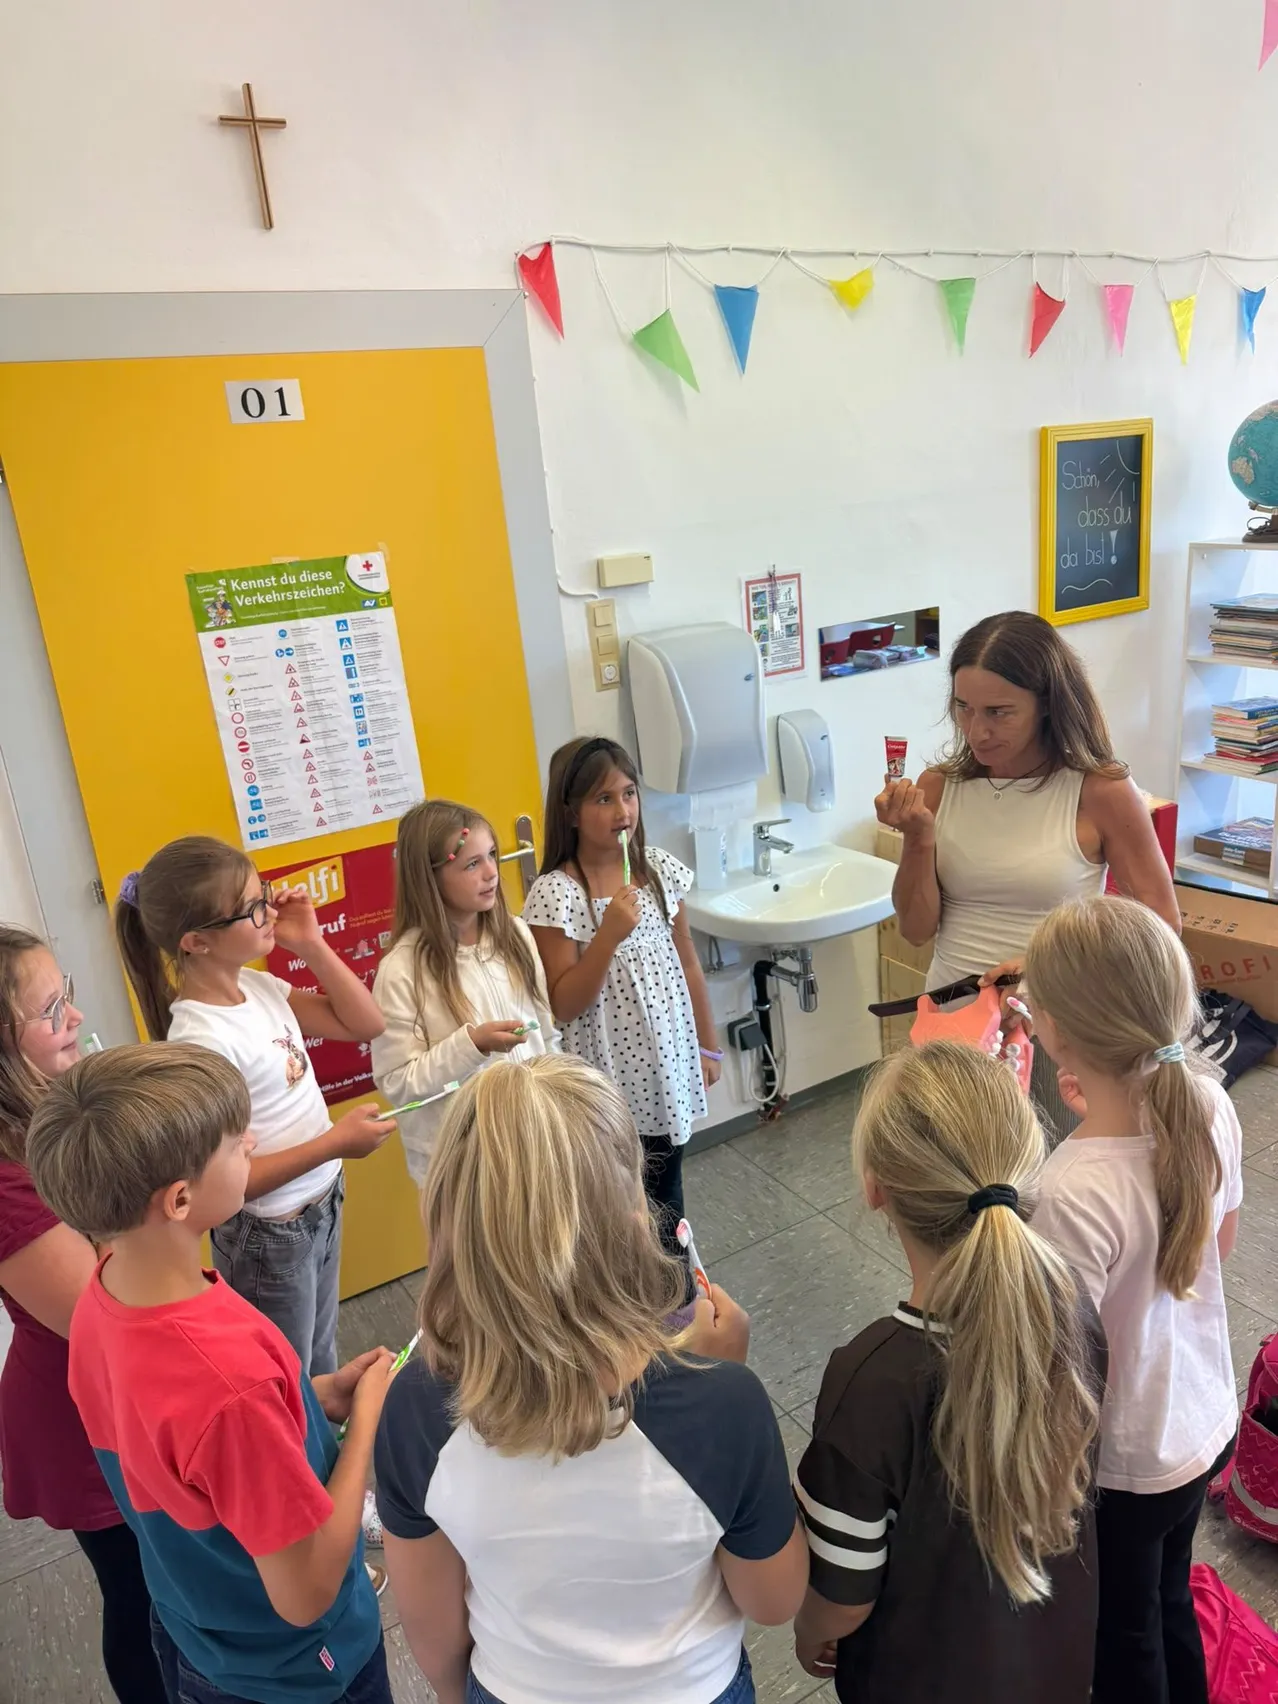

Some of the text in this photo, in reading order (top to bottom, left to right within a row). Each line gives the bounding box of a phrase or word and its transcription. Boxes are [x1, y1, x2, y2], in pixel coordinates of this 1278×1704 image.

[240, 387, 291, 418] 01
[1062, 460, 1100, 490] Schön,
[1078, 490, 1132, 528] dass du
[1060, 536, 1079, 569] da
[230, 576, 278, 592] Kennst
[280, 573, 297, 586] du
[299, 570, 333, 583] diese
[234, 581, 346, 607] Verkehrszeichen?
[1200, 954, 1272, 980] ROFI
